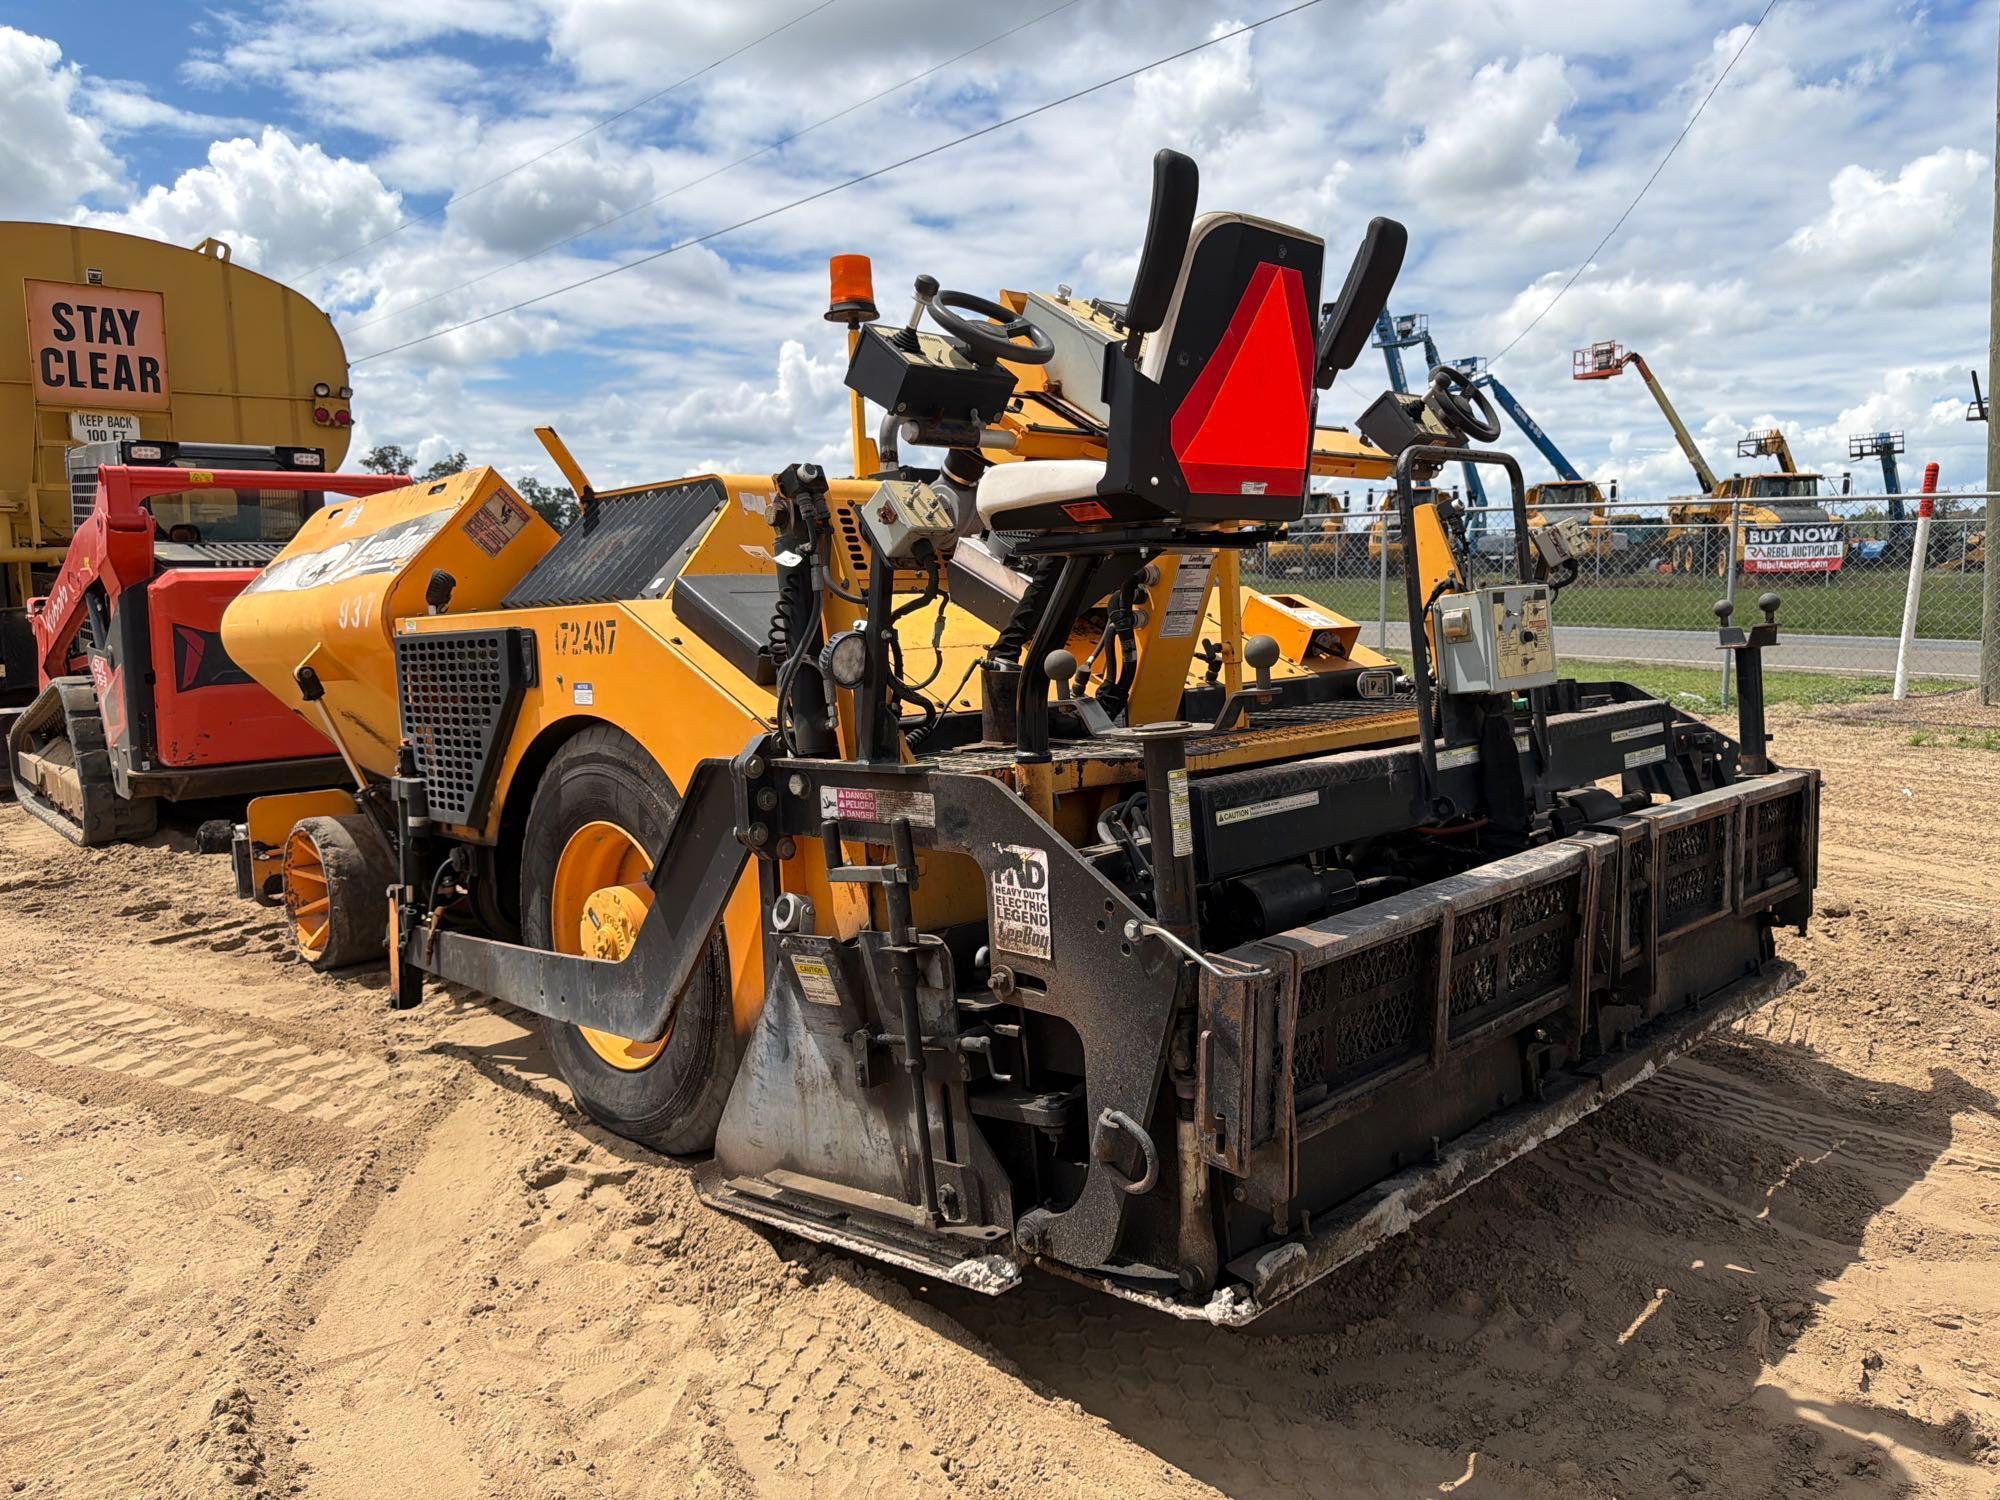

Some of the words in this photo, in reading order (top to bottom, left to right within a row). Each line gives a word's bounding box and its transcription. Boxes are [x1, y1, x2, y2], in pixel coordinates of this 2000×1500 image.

[52, 302, 140, 346] STAY
[40, 347, 161, 393] CLEAR
[79, 414, 104, 427] KEEP
[107, 416, 133, 429] BACK
[86, 429, 107, 441] 100
[113, 431, 127, 440] FT
[1749, 530, 1786, 543] BUY
[1790, 527, 1838, 542] NOW
[1767, 547, 1790, 558] REBEL
[1792, 545, 1825, 557] AUCTION
[1827, 544, 1840, 555] CO.
[1757, 561, 1828, 570] RebelAuction.com
[45, 585, 68, 633] Kubota
[339, 592, 377, 630] 937
[845, 790, 874, 800] DANGER
[845, 800, 875, 810] PELIGRO
[846, 809, 875, 819] DANGER
[1224, 809, 1249, 820] CAUTION
[995, 886, 1023, 899] HEAVY
[1023, 889, 1047, 901] DUTY
[996, 895, 1047, 913] ELECTRIC
[996, 906, 1049, 927] LEGEND
